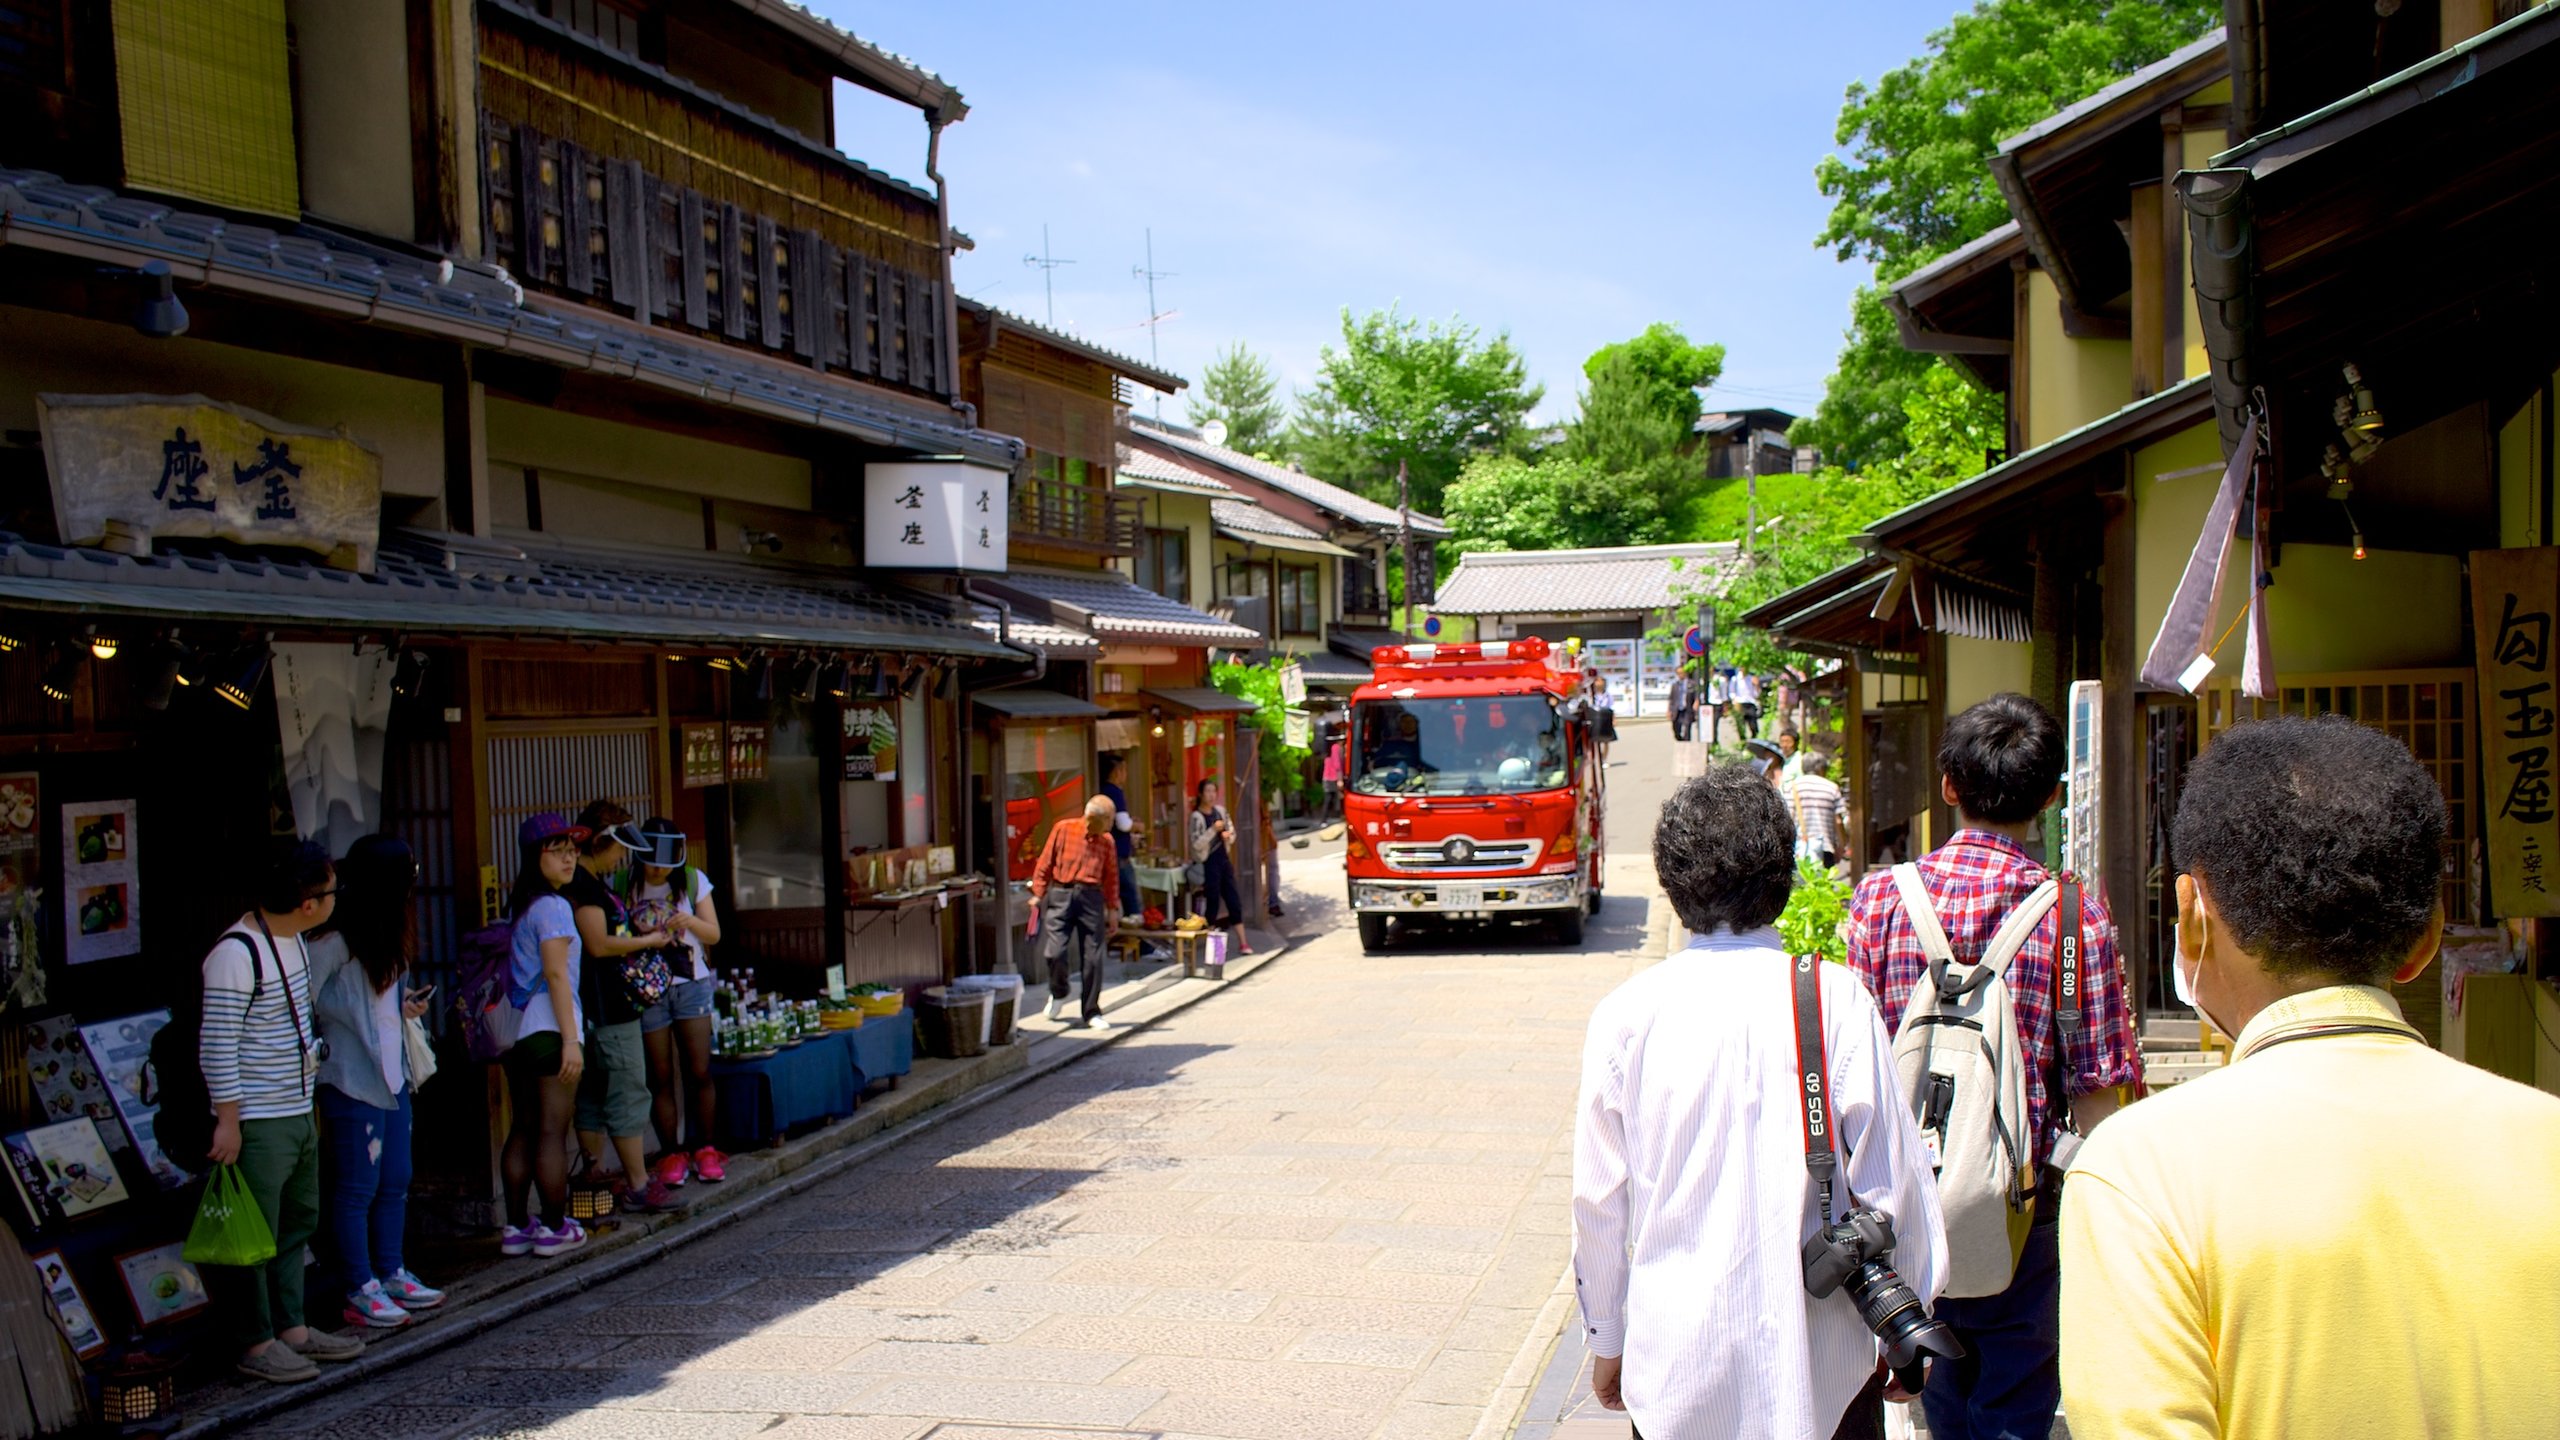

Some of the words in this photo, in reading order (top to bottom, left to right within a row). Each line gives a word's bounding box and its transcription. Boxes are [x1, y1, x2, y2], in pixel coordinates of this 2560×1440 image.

[895, 485, 925, 545] 釜座
[976, 490, 990, 548] 釜座
[2492, 592, 2554, 824] 勾玉屋
[2063, 935, 2076, 970] EOS
[2062, 971, 2076, 997] 60D
[1806, 1071, 1821, 1094] 6D
[1807, 1095, 1825, 1137] EOS
